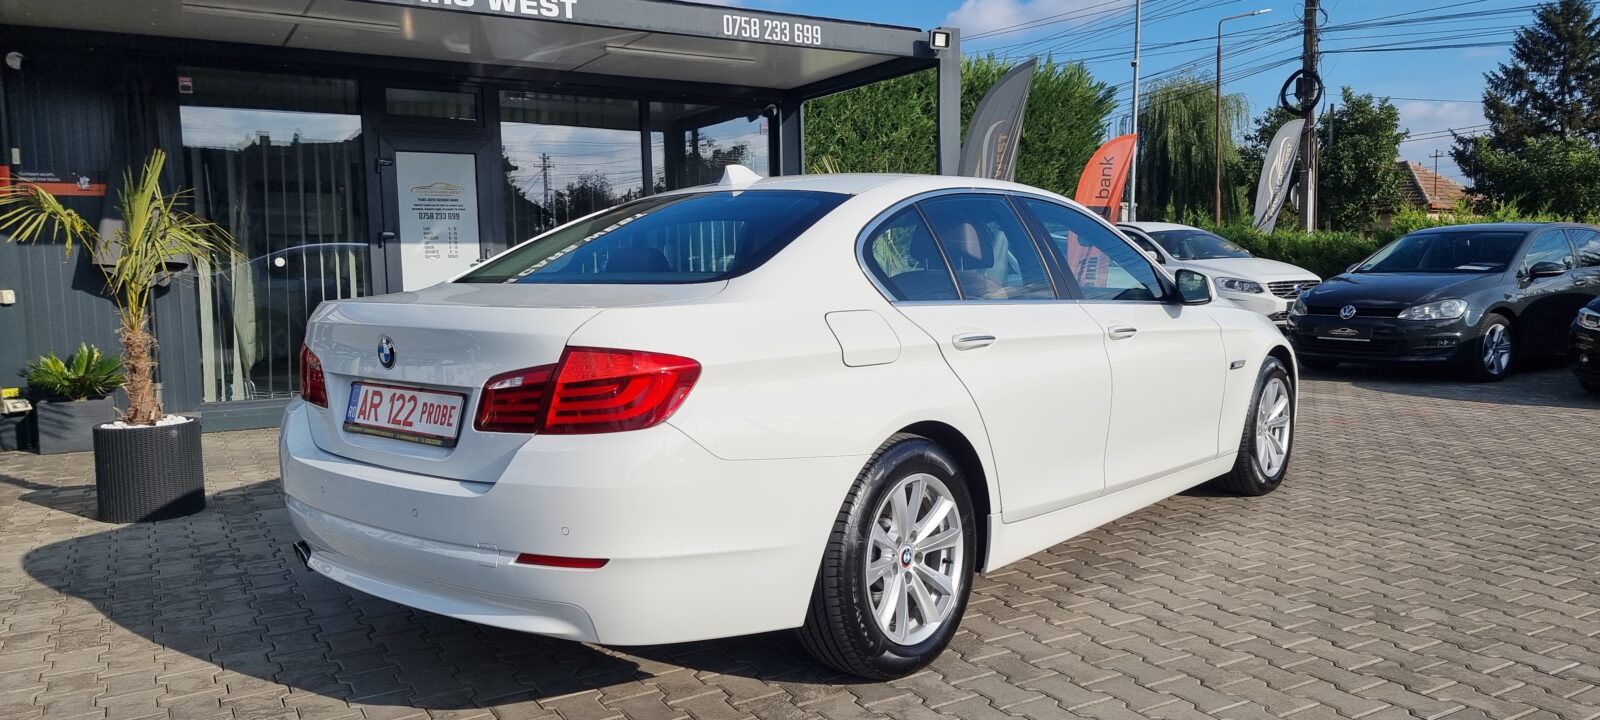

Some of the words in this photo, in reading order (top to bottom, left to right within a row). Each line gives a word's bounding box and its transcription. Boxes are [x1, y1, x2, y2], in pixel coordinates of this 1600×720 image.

[488, 0, 577, 19] WEST
[723, 14, 760, 38] 0758
[764, 19, 790, 42] 233
[794, 23, 821, 45] 699
[1095, 156, 1114, 199] bank
[419, 212, 434, 220] 0758
[435, 212, 447, 220] 233
[448, 212, 460, 220] 699
[348, 405, 356, 418] RO
[357, 389, 384, 422] AR
[387, 392, 418, 427] 122
[419, 401, 456, 427] PROBE
